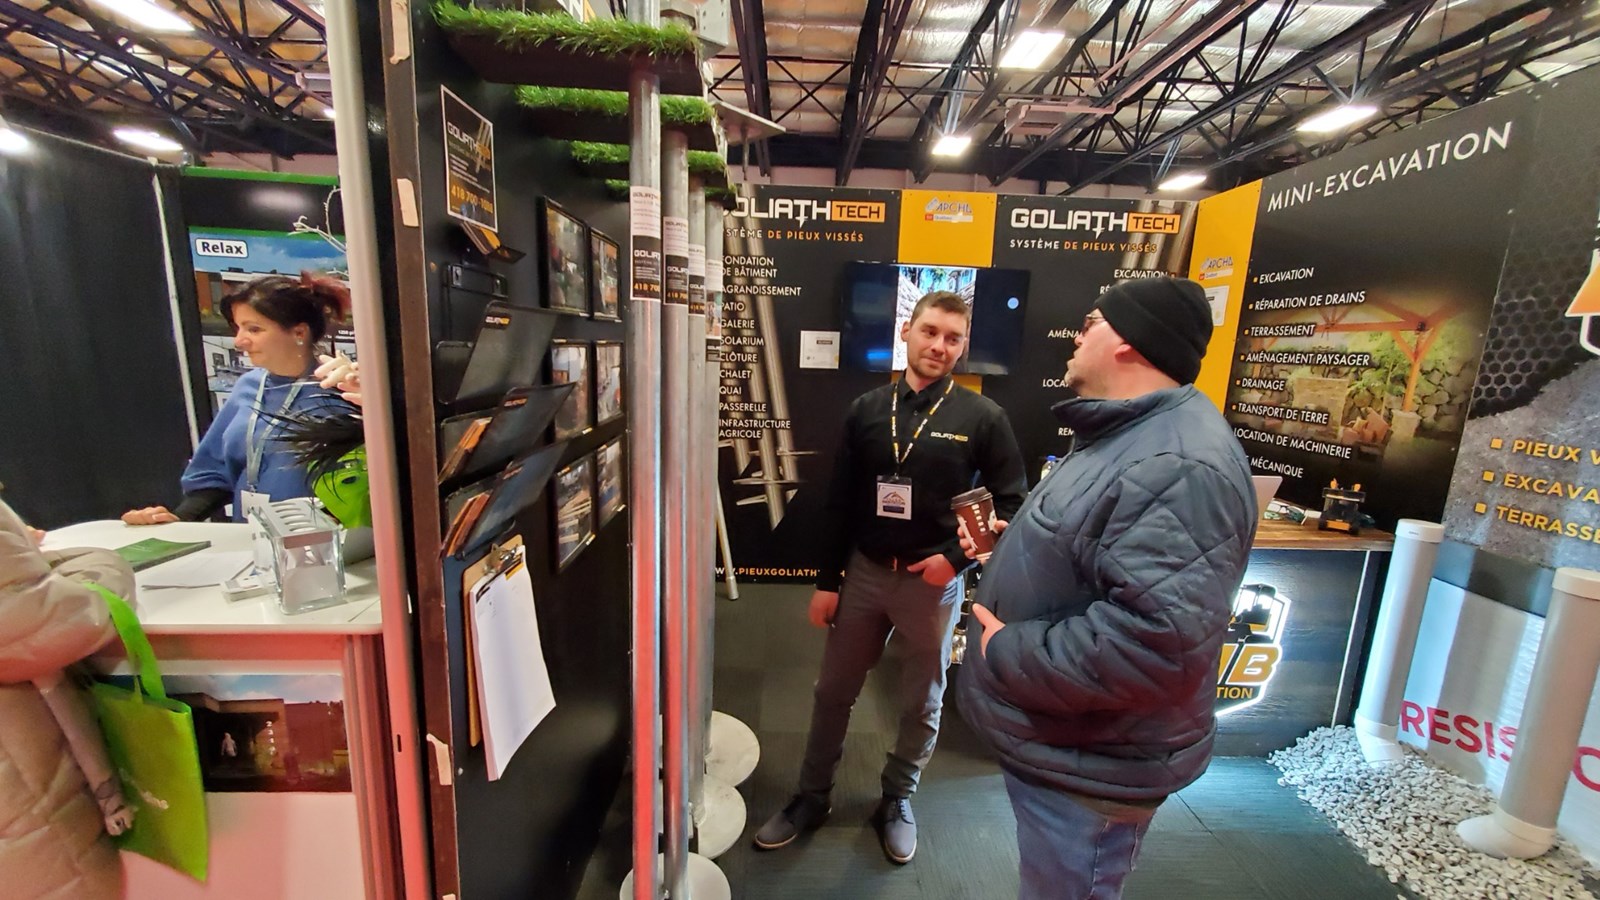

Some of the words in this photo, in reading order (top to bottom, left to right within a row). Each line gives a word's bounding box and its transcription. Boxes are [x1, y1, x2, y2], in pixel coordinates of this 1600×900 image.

[1266, 121, 1513, 213] MINI-EXCAVATION
[767, 230, 781, 239] DE
[787, 230, 820, 241] PIEUX
[825, 230, 864, 242] VISSÉS
[201, 241, 244, 255] Relax
[1010, 237, 1060, 250] SYSTÈME
[1064, 240, 1079, 251] DE
[1082, 241, 1115, 252] PIEUX
[1120, 239, 1158, 253] VISSÉS
[734, 265, 778, 278] BÂTIMENT
[1259, 267, 1314, 284] EXCAVATION
[721, 284, 802, 296] AGRANDISSEMENT
[1255, 295, 1307, 311] RÉPARATION
[1310, 294, 1323, 307] DE
[1325, 290, 1366, 305] DRAINS
[721, 319, 755, 329] GALERIE
[1250, 324, 1315, 337] TERRASSEMENT
[720, 336, 765, 346] SOLARIUM
[720, 350, 758, 362] CLÔTURE
[1245, 352, 1315, 365] AMÉNAGEMENT
[1316, 353, 1370, 366] PAYSAGER
[720, 369, 752, 379] CHALET
[719, 386, 742, 396] QUAI
[1241, 377, 1285, 392] DRAINAGE
[719, 403, 767, 412] PASSERELLE
[1238, 402, 1283, 418] TRANSPORT
[1286, 409, 1299, 420] DE
[1301, 410, 1329, 425] TERRE
[719, 419, 791, 429] INFRASTRUCTURE
[719, 429, 762, 439] AGRICOLE
[1233, 427, 1274, 444] LOCATION
[1276, 435, 1289, 447] DE
[1290, 438, 1352, 459] MACHINERIE
[1512, 439, 1581, 463] PIEUX
[1250, 456, 1304, 479] MÉCANIQUE
[1504, 472, 1600, 505] EXCAVA
